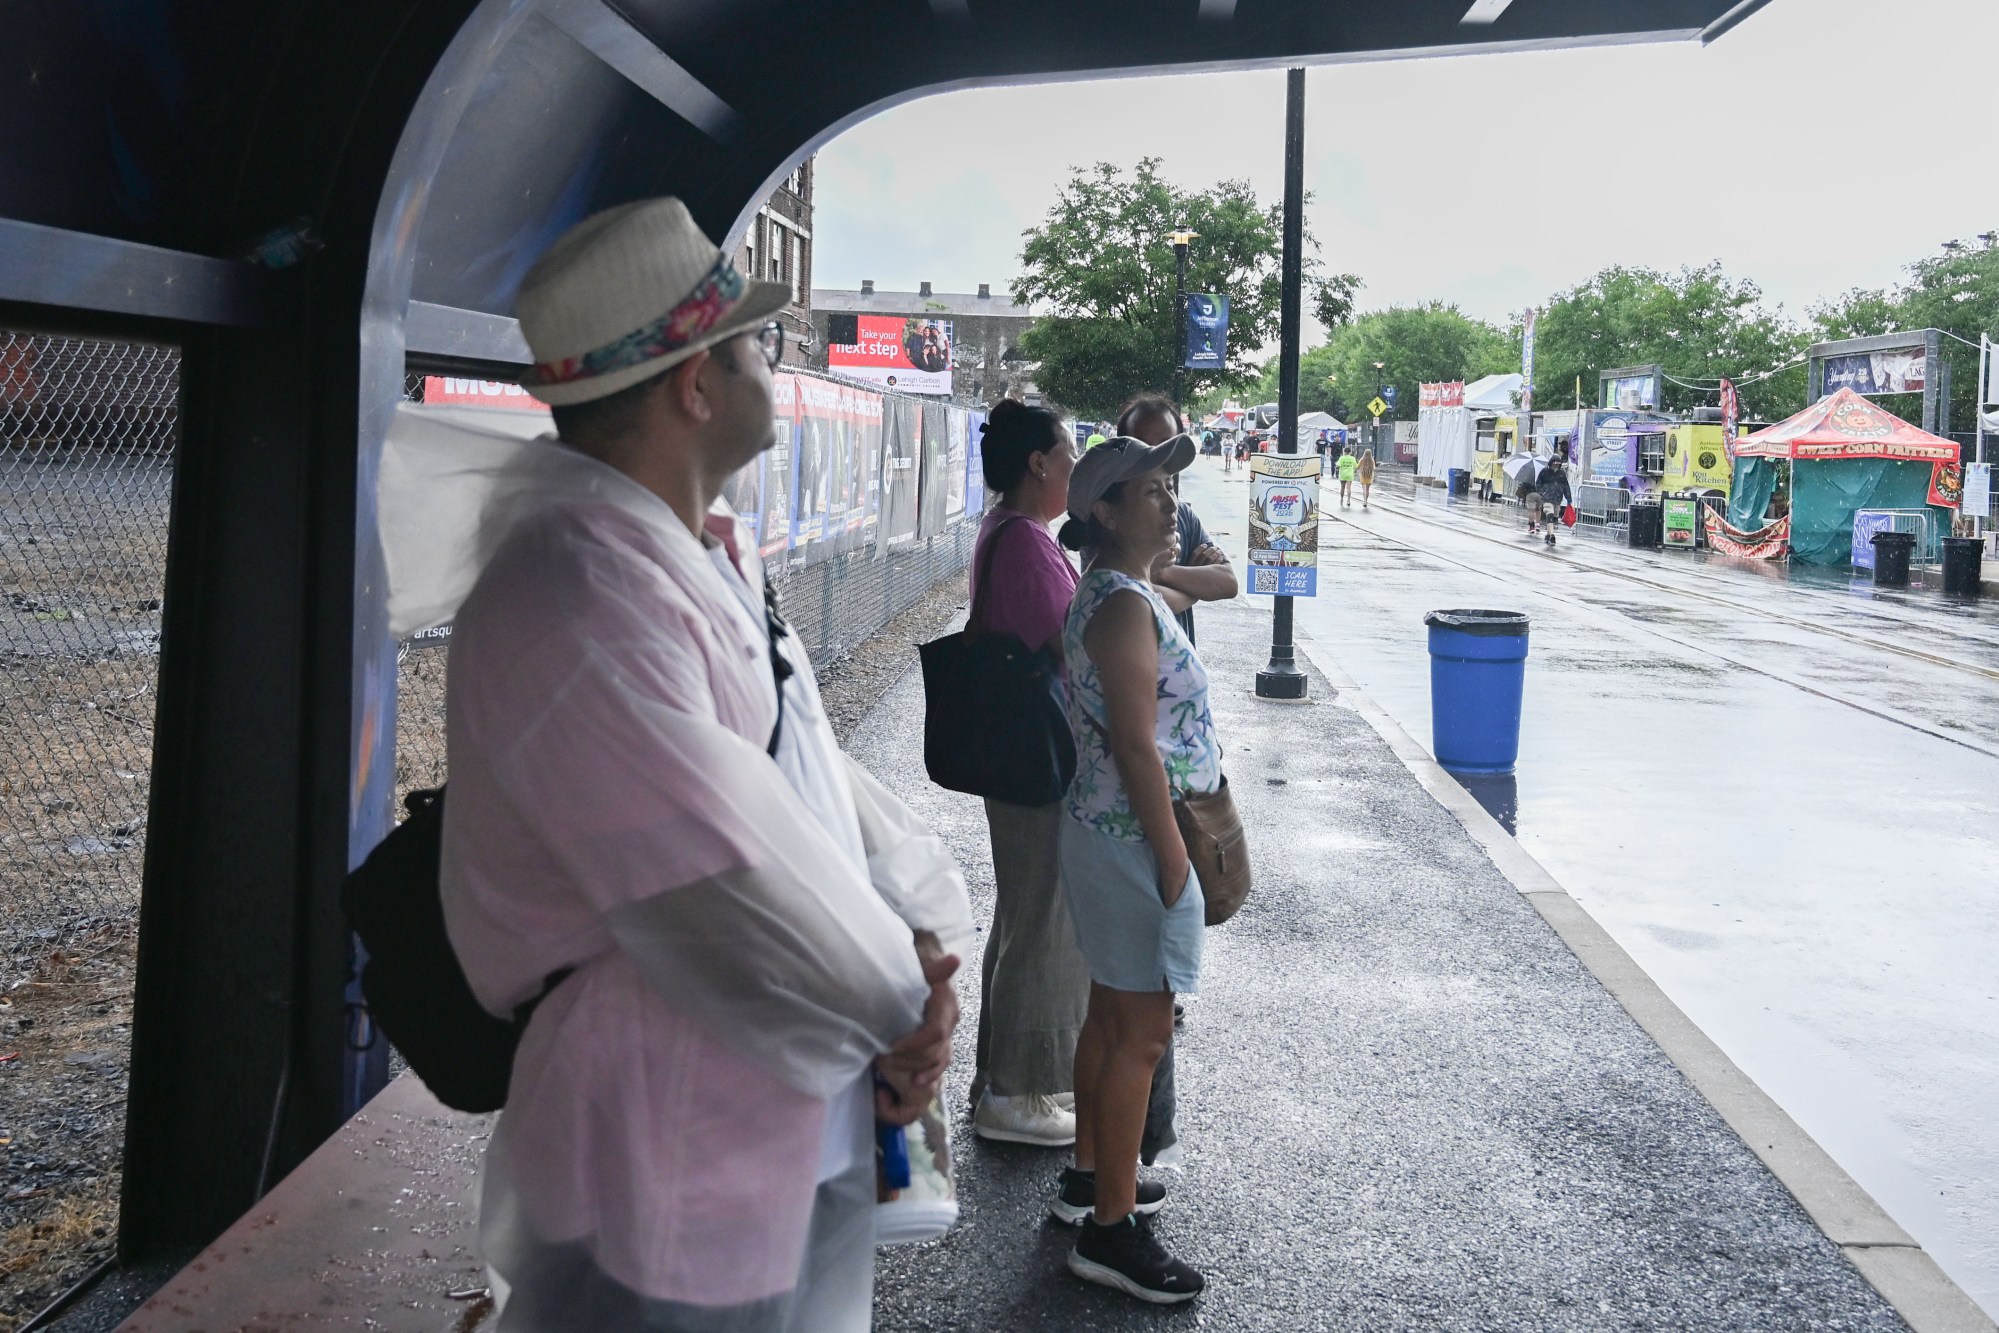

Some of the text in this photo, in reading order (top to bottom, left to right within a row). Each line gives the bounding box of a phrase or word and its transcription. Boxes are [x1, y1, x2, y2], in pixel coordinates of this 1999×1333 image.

[861, 329, 897, 341] Take your
[836, 342, 899, 360] next step
[898, 376, 940, 384] Lehigh Carbon
[1836, 403, 1873, 416] CORN
[1797, 444, 1843, 455] SWEET
[1845, 442, 1885, 454] CORN
[1887, 443, 1954, 459] FRITTERS
[1263, 459, 1307, 469] DOWNLOAD
[1268, 467, 1303, 477] THE APP!
[1695, 476, 1727, 484] Kitchen
[1270, 494, 1299, 503] MUSIK
[1273, 503, 1293, 511] FEST
[1285, 571, 1308, 580] SCAN
[1285, 580, 1308, 588] HERE
[414, 625, 453, 639] artsqu
